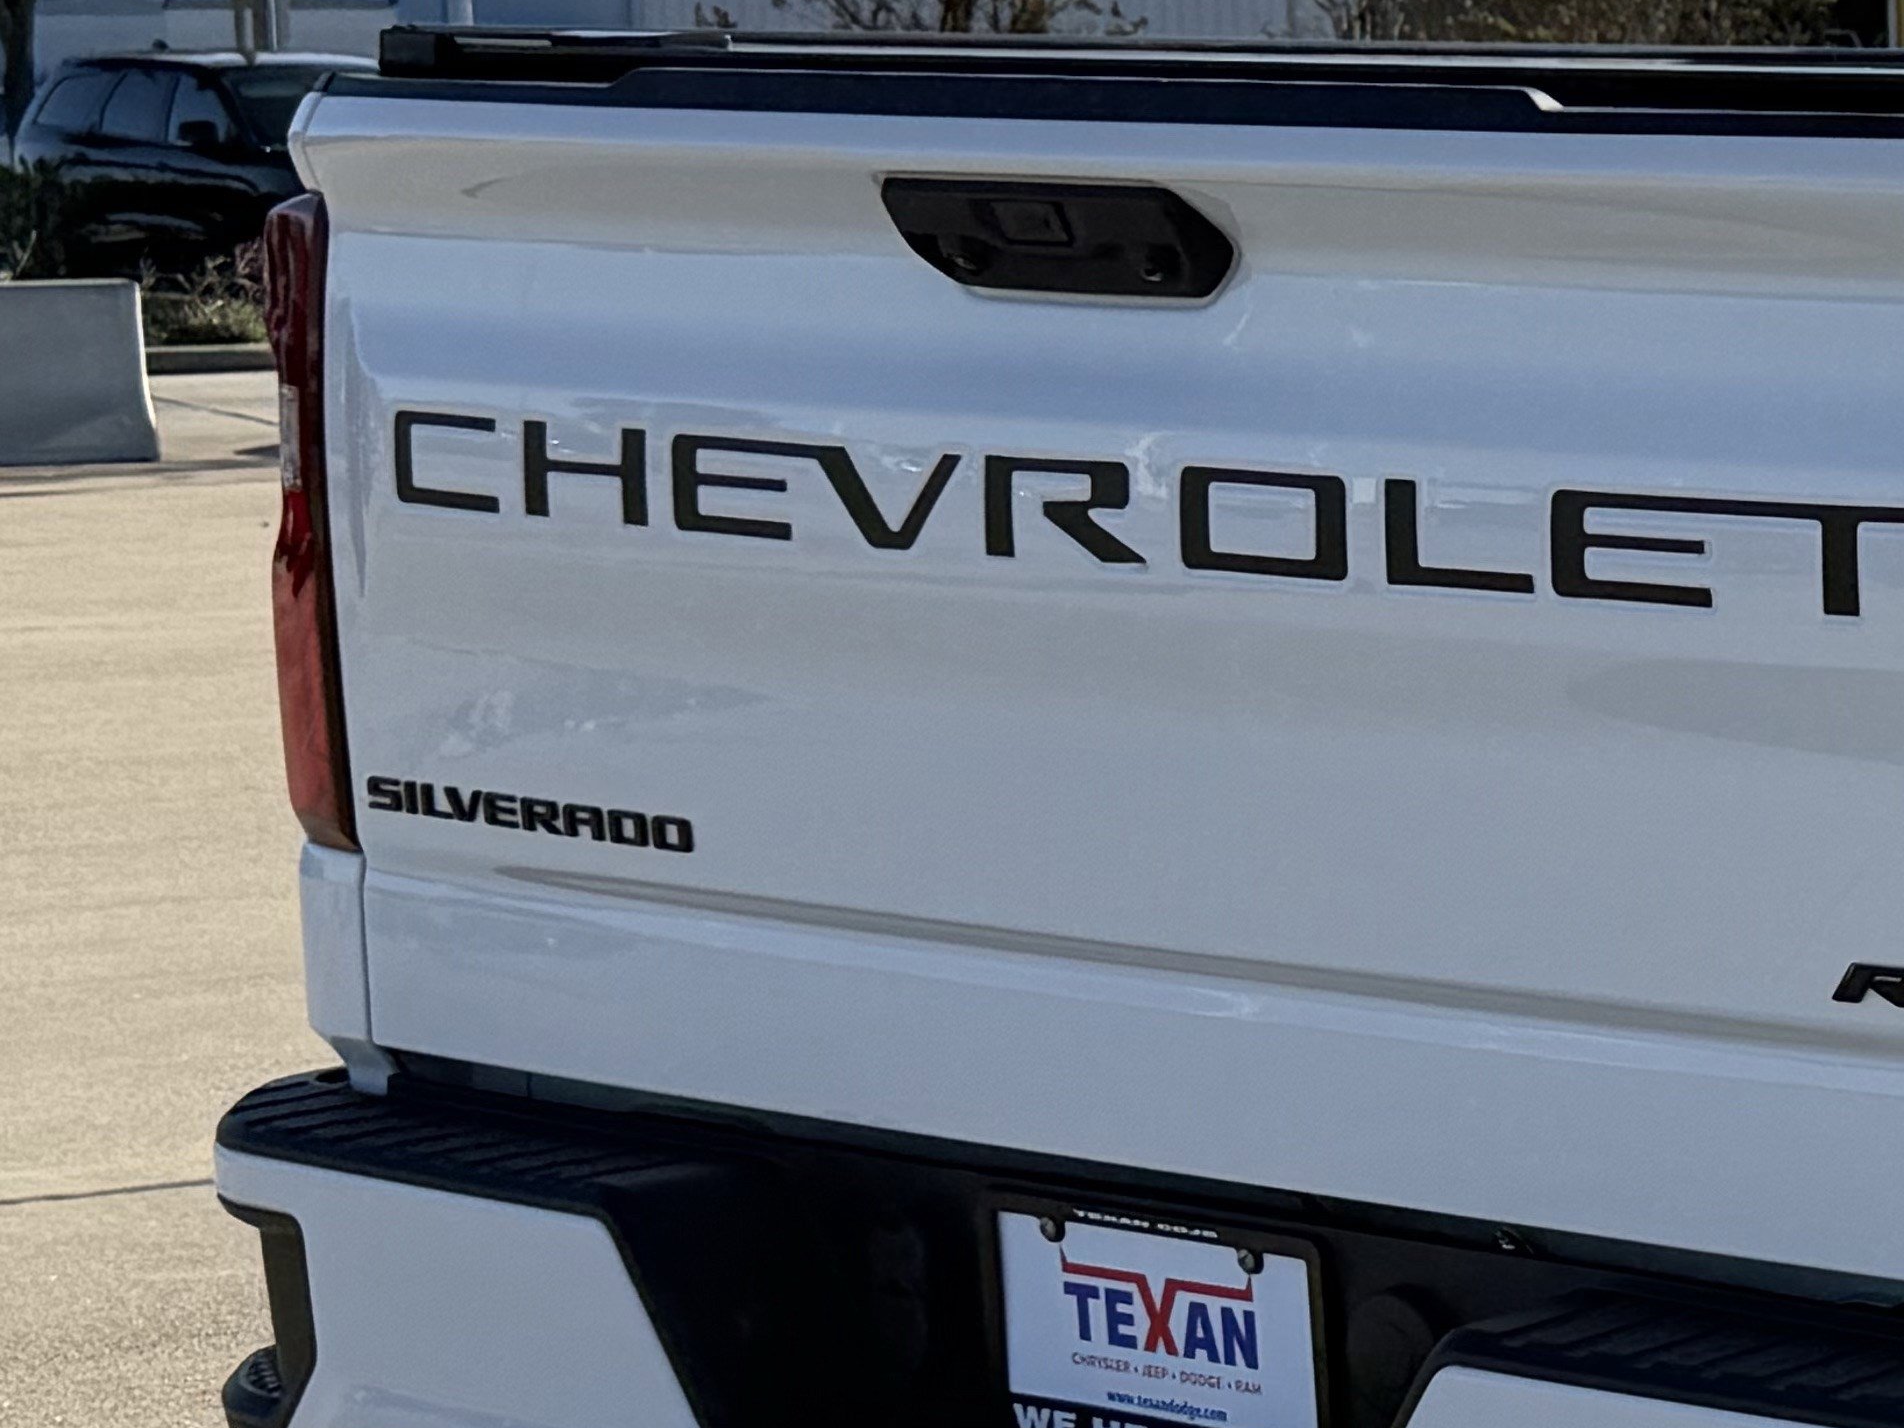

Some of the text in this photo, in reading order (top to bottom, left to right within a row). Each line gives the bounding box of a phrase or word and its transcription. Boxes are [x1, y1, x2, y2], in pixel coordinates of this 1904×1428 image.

[368, 776, 694, 853] SILVERADO
[1060, 1248, 1259, 1370] TEXAN
[1072, 1352, 1263, 1396] CHRYSLER JEEP DODGE RAM
[1106, 1390, 1228, 1422] www.texandodge.com
